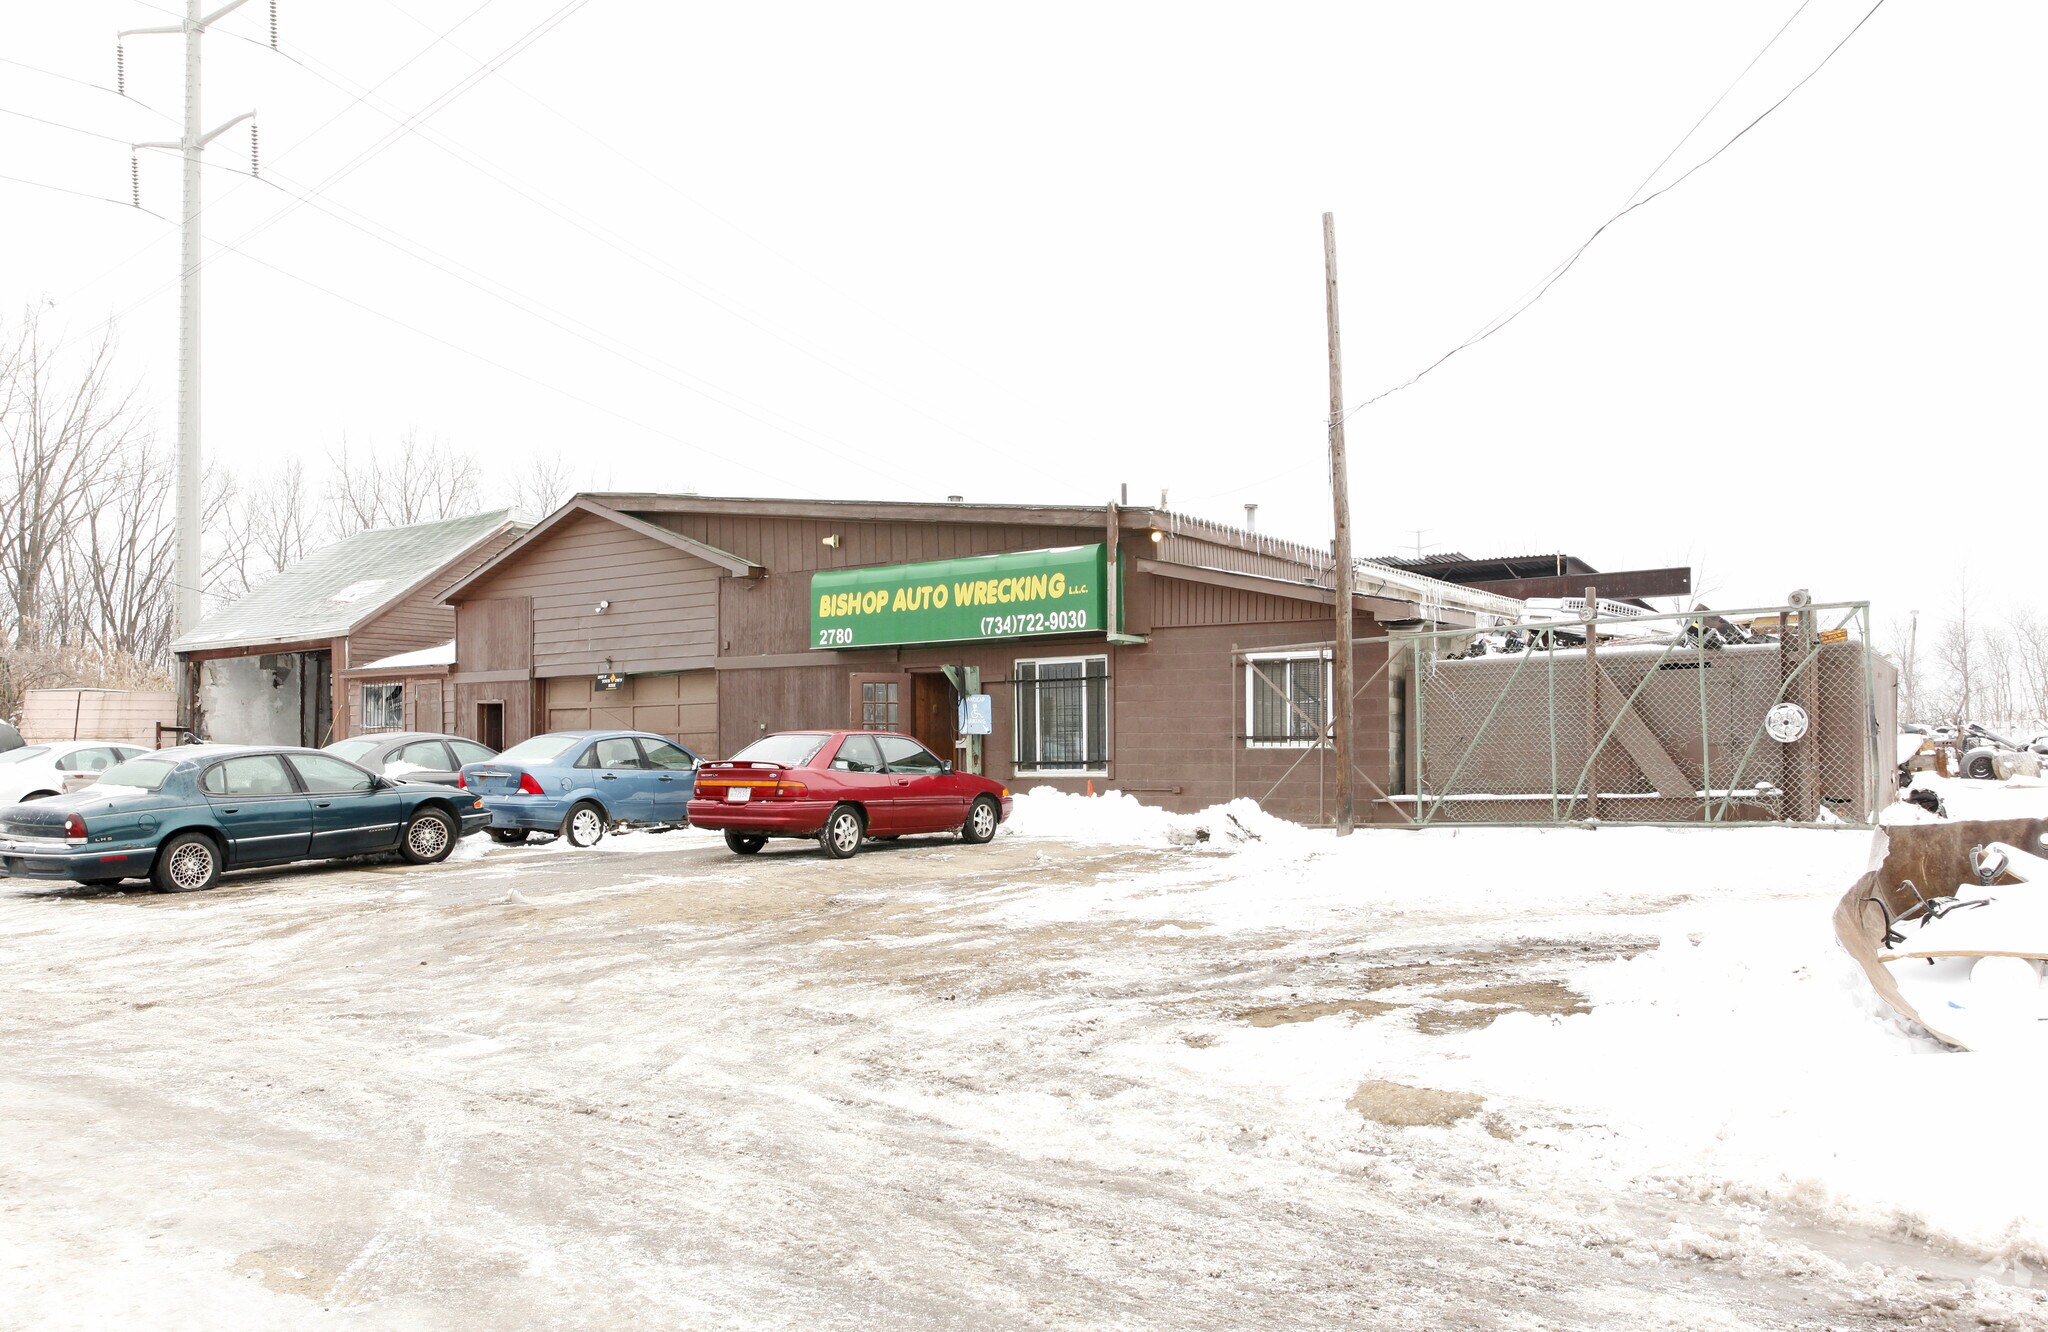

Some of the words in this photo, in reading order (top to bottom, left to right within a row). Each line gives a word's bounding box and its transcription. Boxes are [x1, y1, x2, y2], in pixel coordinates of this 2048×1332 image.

[819, 590, 889, 618] BISHOP
[892, 583, 949, 612] AUTO
[954, 572, 1066, 607] WRECKING
[1068, 584, 1089, 595] L.L.C.
[819, 628, 853, 645] 2780
[980, 609, 1087, 636] (734)722-9030
